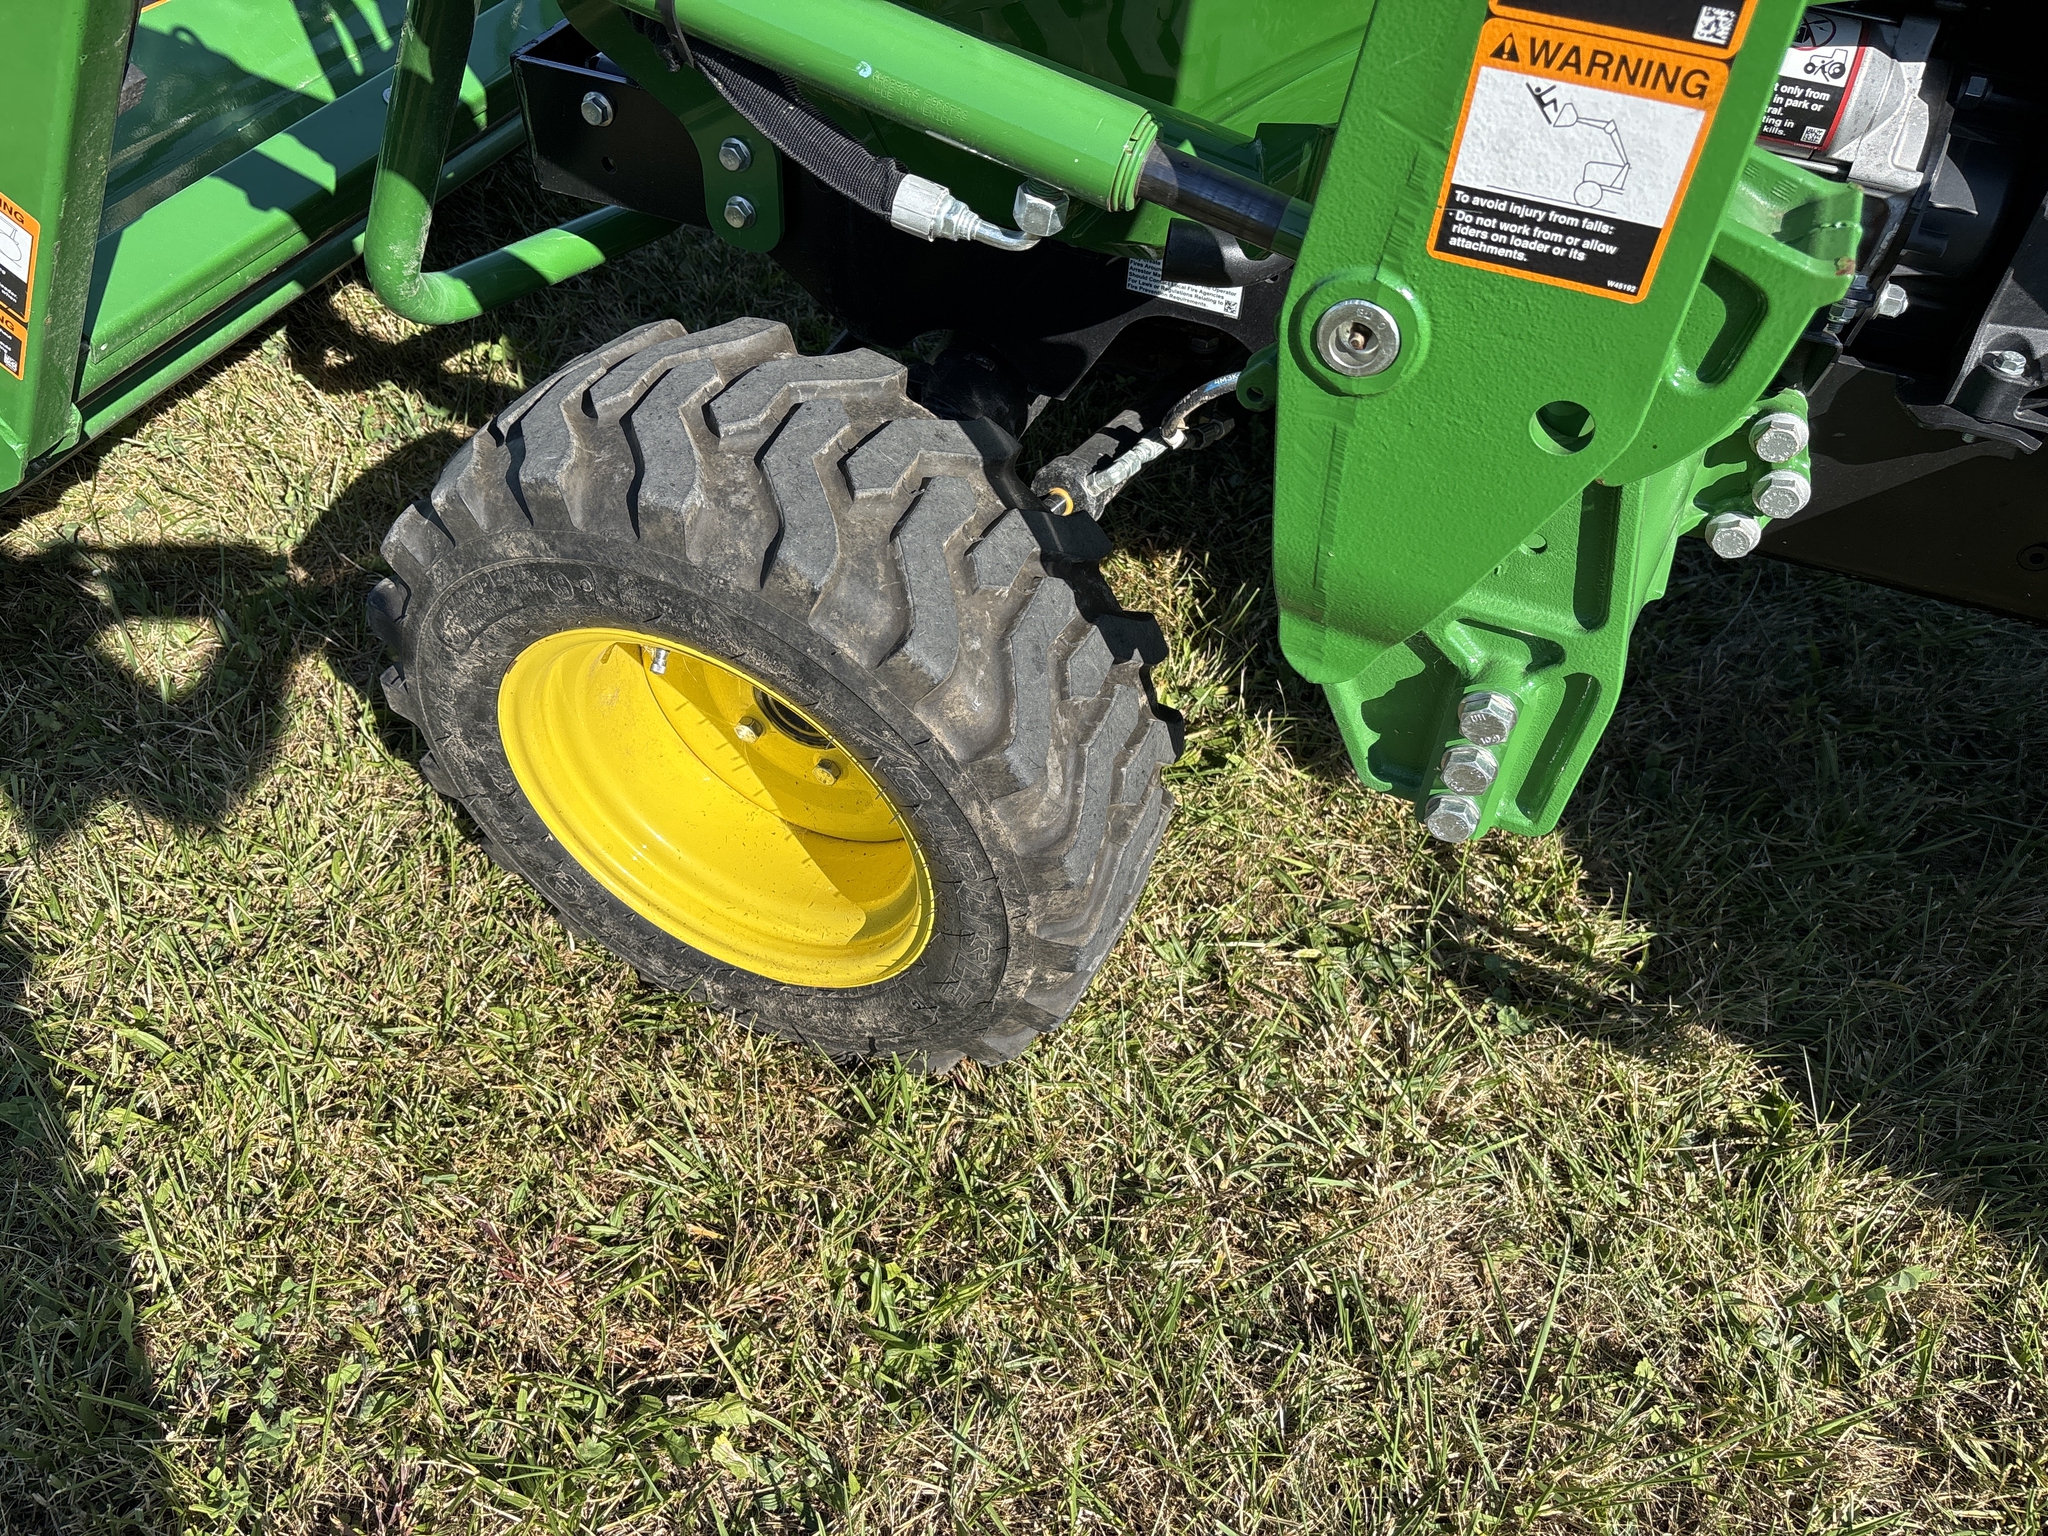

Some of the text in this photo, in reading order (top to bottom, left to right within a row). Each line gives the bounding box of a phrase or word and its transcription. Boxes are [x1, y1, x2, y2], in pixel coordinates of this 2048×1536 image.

[1529, 36, 1711, 101] WARNING
[1772, 94, 1824, 112] in park or
[1780, 85, 1805, 98] only
[1805, 87, 1830, 101] from
[1762, 125, 1786, 136] kills.
[1784, 119, 1795, 128] in
[1454, 190, 1616, 235] To avoid injury from falls:
[1452, 223, 1587, 261] riders on loader or its
[1455, 210, 1619, 255] Do not work from or allow
[1448, 236, 1529, 262] attachments.
[1144, 263, 1162, 271] Aroun
[1128, 271, 1148, 281] Should
[1187, 285, 1198, 293] Fire
[1199, 289, 1225, 300] Agencies
[1138, 280, 1153, 288] Laws
[1160, 285, 1193, 298] Regulations
[1194, 294, 1217, 305] Relating
[1606, 279, 1637, 293] W45192
